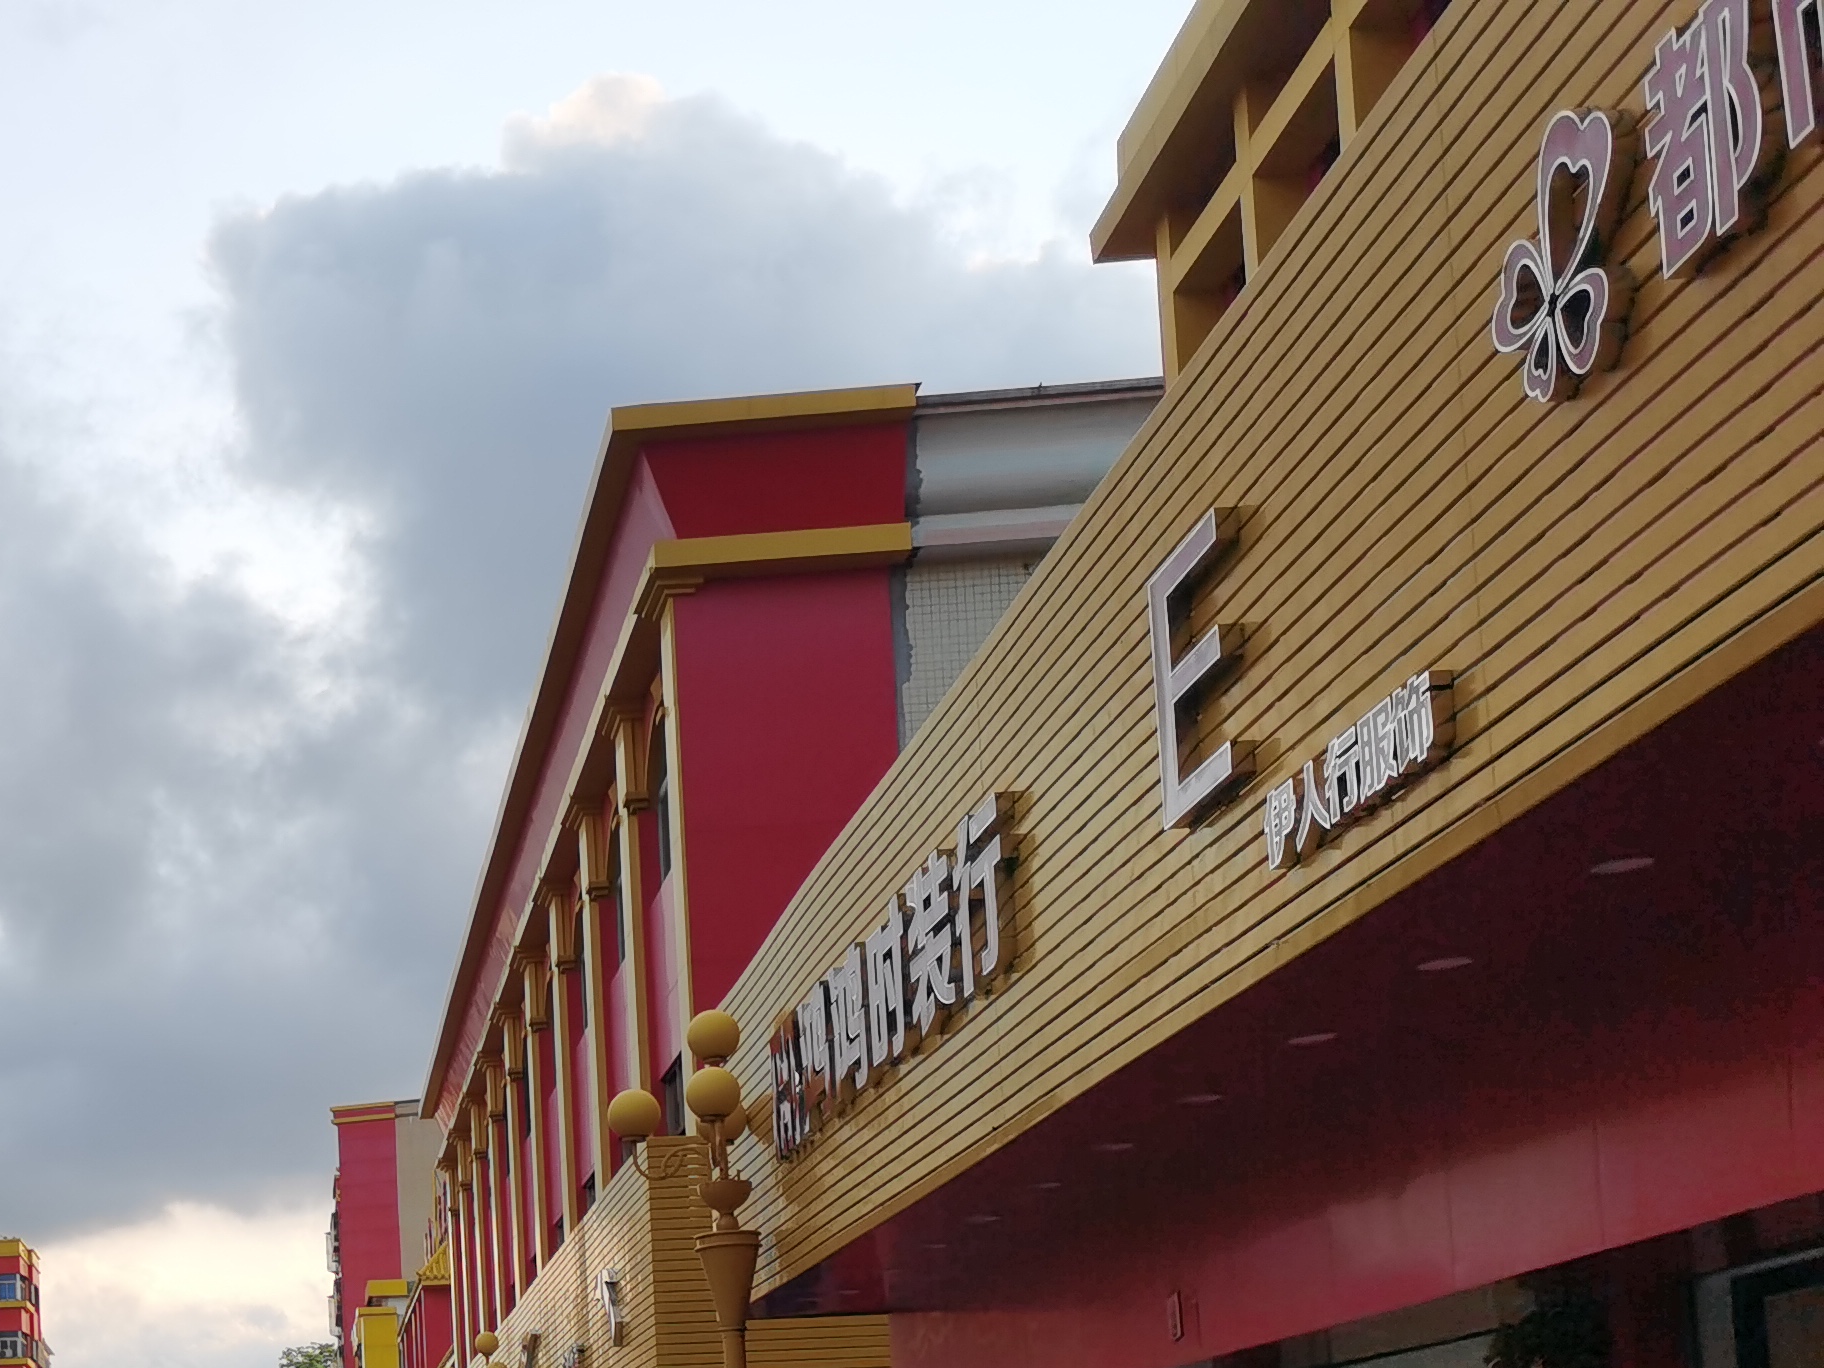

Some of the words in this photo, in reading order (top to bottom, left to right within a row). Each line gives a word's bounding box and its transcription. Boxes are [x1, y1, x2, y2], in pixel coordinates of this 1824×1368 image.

[1644, 0, 1824, 280] 都
[1264, 670, 1435, 871] 伊人行服饰
